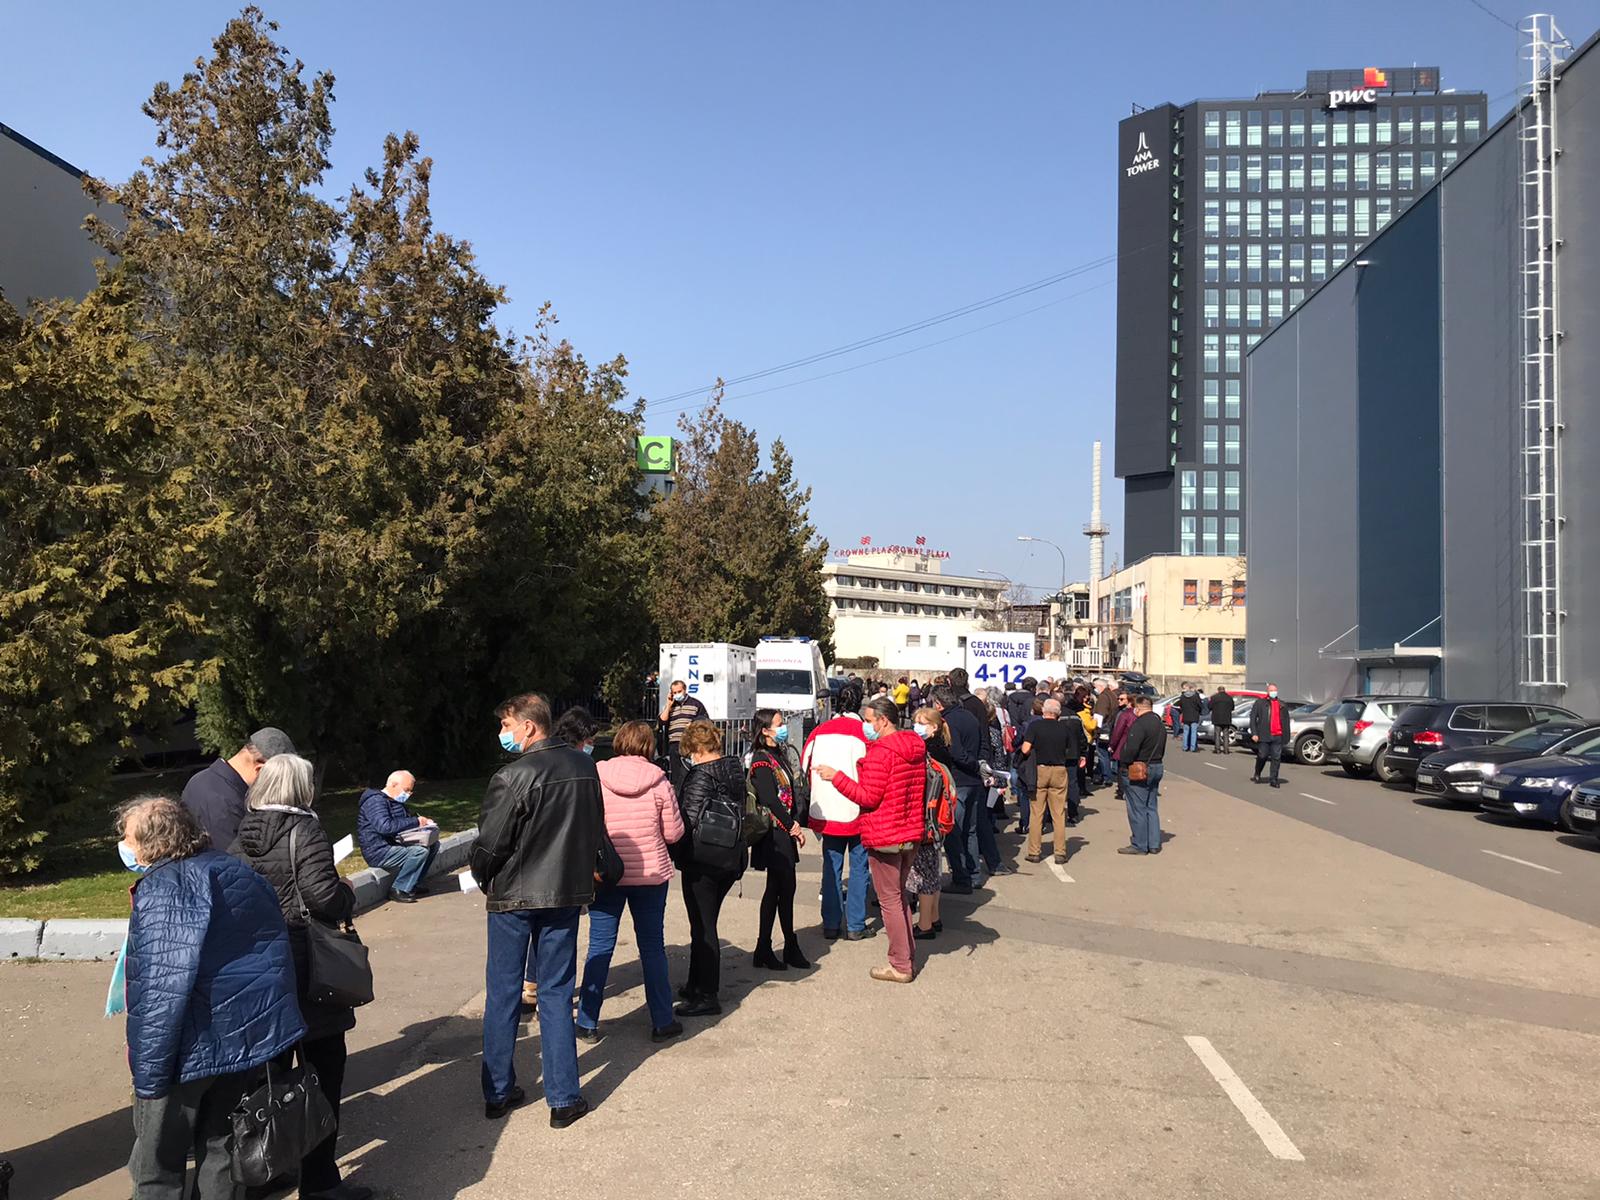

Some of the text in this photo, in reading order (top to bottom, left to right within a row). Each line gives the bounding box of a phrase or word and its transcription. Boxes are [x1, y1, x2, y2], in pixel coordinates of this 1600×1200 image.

[1328, 88, 1376, 109] pwc
[1132, 150, 1153, 165] ANA
[1125, 158, 1160, 177] TOWER
[834, 547, 869, 557] CROWNE
[926, 549, 951, 559] PLAZA
[971, 641, 1015, 650] CENTRUL
[973, 650, 1028, 658] VACCINARE
[975, 663, 1027, 683] 4-12
